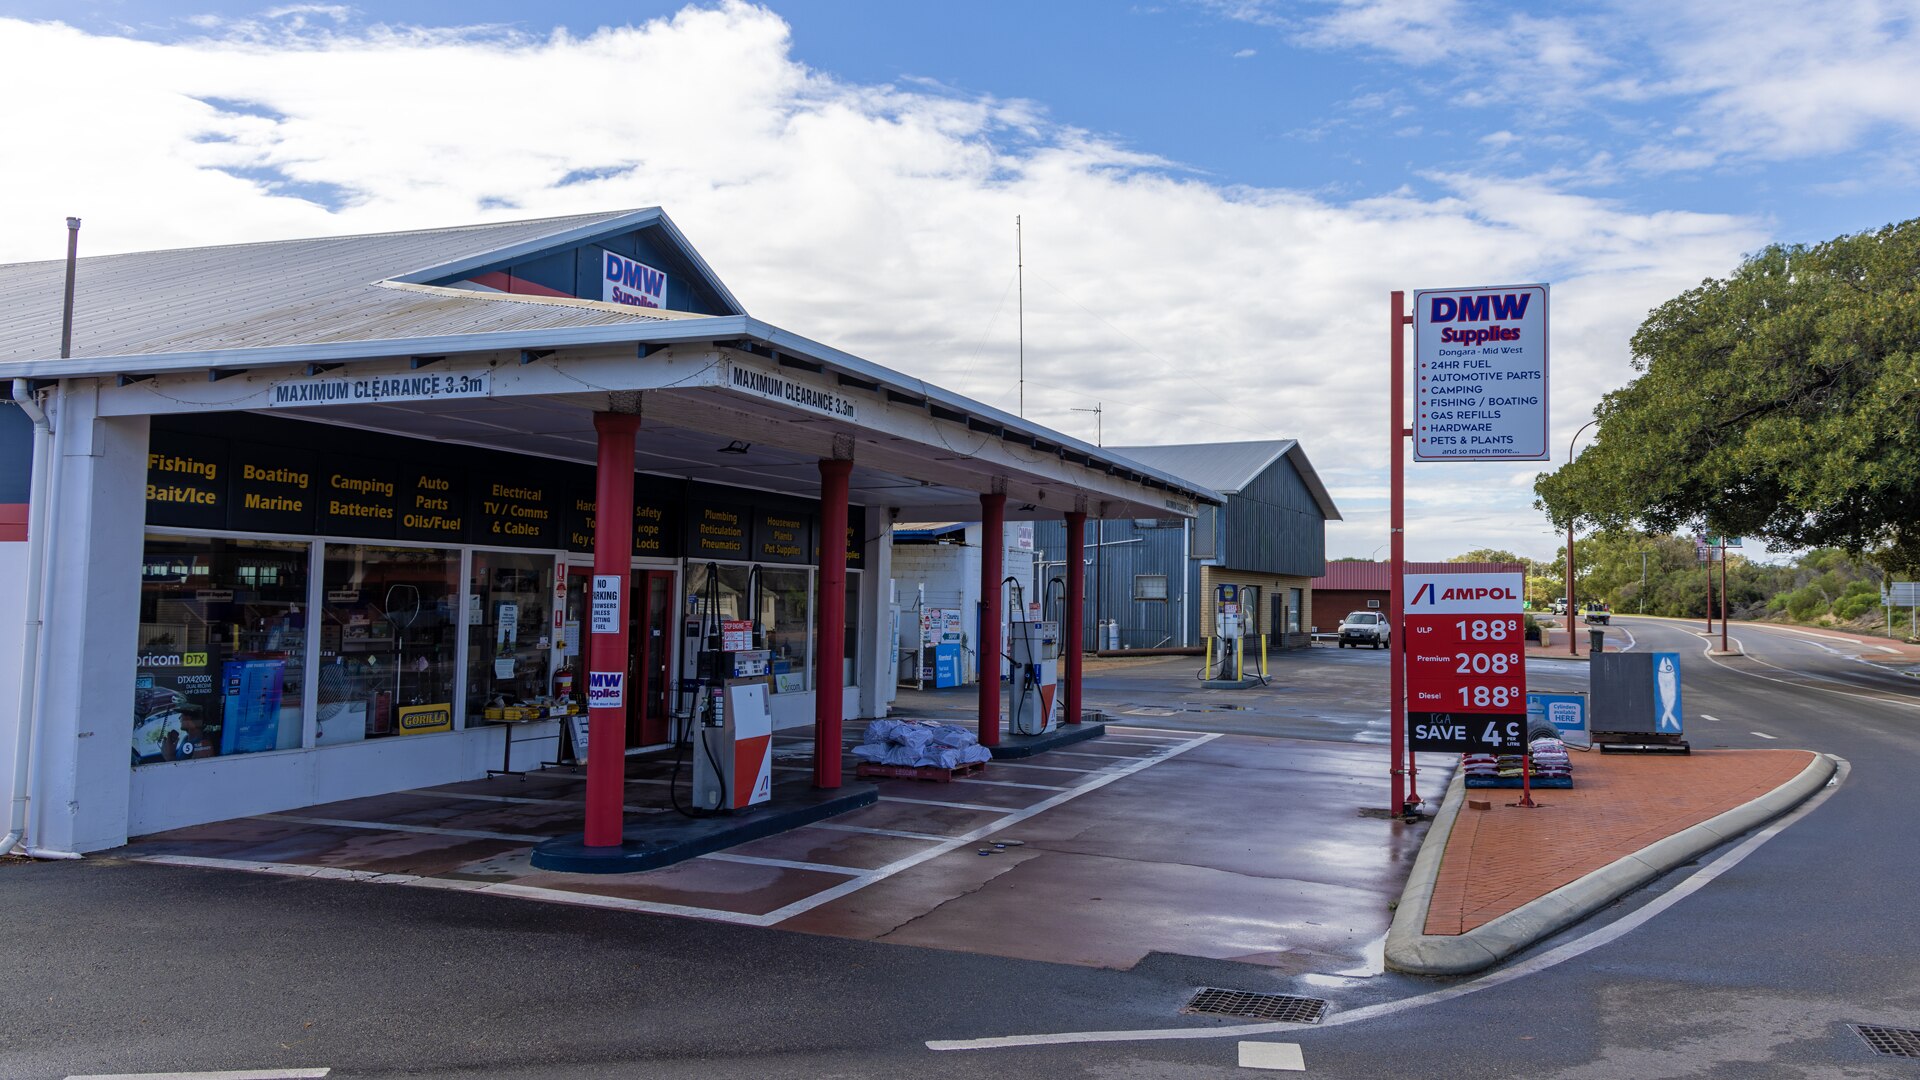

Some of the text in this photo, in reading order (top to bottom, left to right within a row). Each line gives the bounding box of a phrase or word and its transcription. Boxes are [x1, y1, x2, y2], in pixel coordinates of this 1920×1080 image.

[606, 253, 665, 298] DMW
[1430, 293, 1532, 323] DMW
[1441, 325, 1521, 346] Supplies
[1439, 349, 1476, 358] Dongara
[1482, 347, 1498, 355] Mid
[1501, 346, 1523, 354] West
[1431, 360, 1491, 370] 24HR FUEL
[1431, 370, 1541, 382] AUTOMOTIVE PARTS
[276, 375, 482, 403] MAXIMUM CLEARANCE 3.3m
[733, 366, 855, 418] MAXIMUM CLEARANCE 3.3m
[1431, 385, 1483, 395] CAMPING
[1430, 396, 1538, 407] FISHING / BOATING
[1431, 410, 1501, 420] GAS REFILLS
[1430, 423, 1492, 432] HARDWARE
[1430, 435, 1514, 445] PETS & PLANTS
[1469, 447, 1490, 455] much
[147, 453, 217, 480] Fishing
[243, 464, 309, 489] Boating
[418, 475, 449, 491] Auto
[330, 474, 394, 497] Camping
[146, 484, 216, 505] Bait/Ice
[492, 484, 541, 502] Electrical
[245, 493, 303, 512] Marine
[329, 500, 394, 519] Batteries
[416, 495, 448, 511] Parts
[484, 501, 499, 515] TV
[511, 504, 549, 520] Comms
[636, 506, 662, 521] Safety
[705, 509, 738, 525] Plumbing
[403, 513, 461, 531] Oils/Fuel
[492, 521, 540, 537] & Cables
[767, 516, 801, 529] Houseware
[700, 524, 742, 537] Reticulation
[774, 531, 793, 542] Plants
[572, 532, 589, 547] Key
[636, 538, 660, 550] Locks
[701, 538, 741, 552] Pneumatics
[764, 543, 801, 557] Pet Supplies
[597, 579, 607, 588] NO
[1441, 586, 1517, 601] AMPOL
[1417, 626, 1433, 635] ULP
[186, 654, 205, 664] DTX
[1417, 655, 1450, 663] Premium
[177, 675, 212, 684] DTX4200X
[589, 673, 622, 687] MW
[589, 688, 621, 700] pplies
[1418, 692, 1441, 700] Diesel
[404, 712, 447, 726] GORILLA
[1415, 724, 1467, 740] SAVE
[1481, 721, 1503, 747] 4
